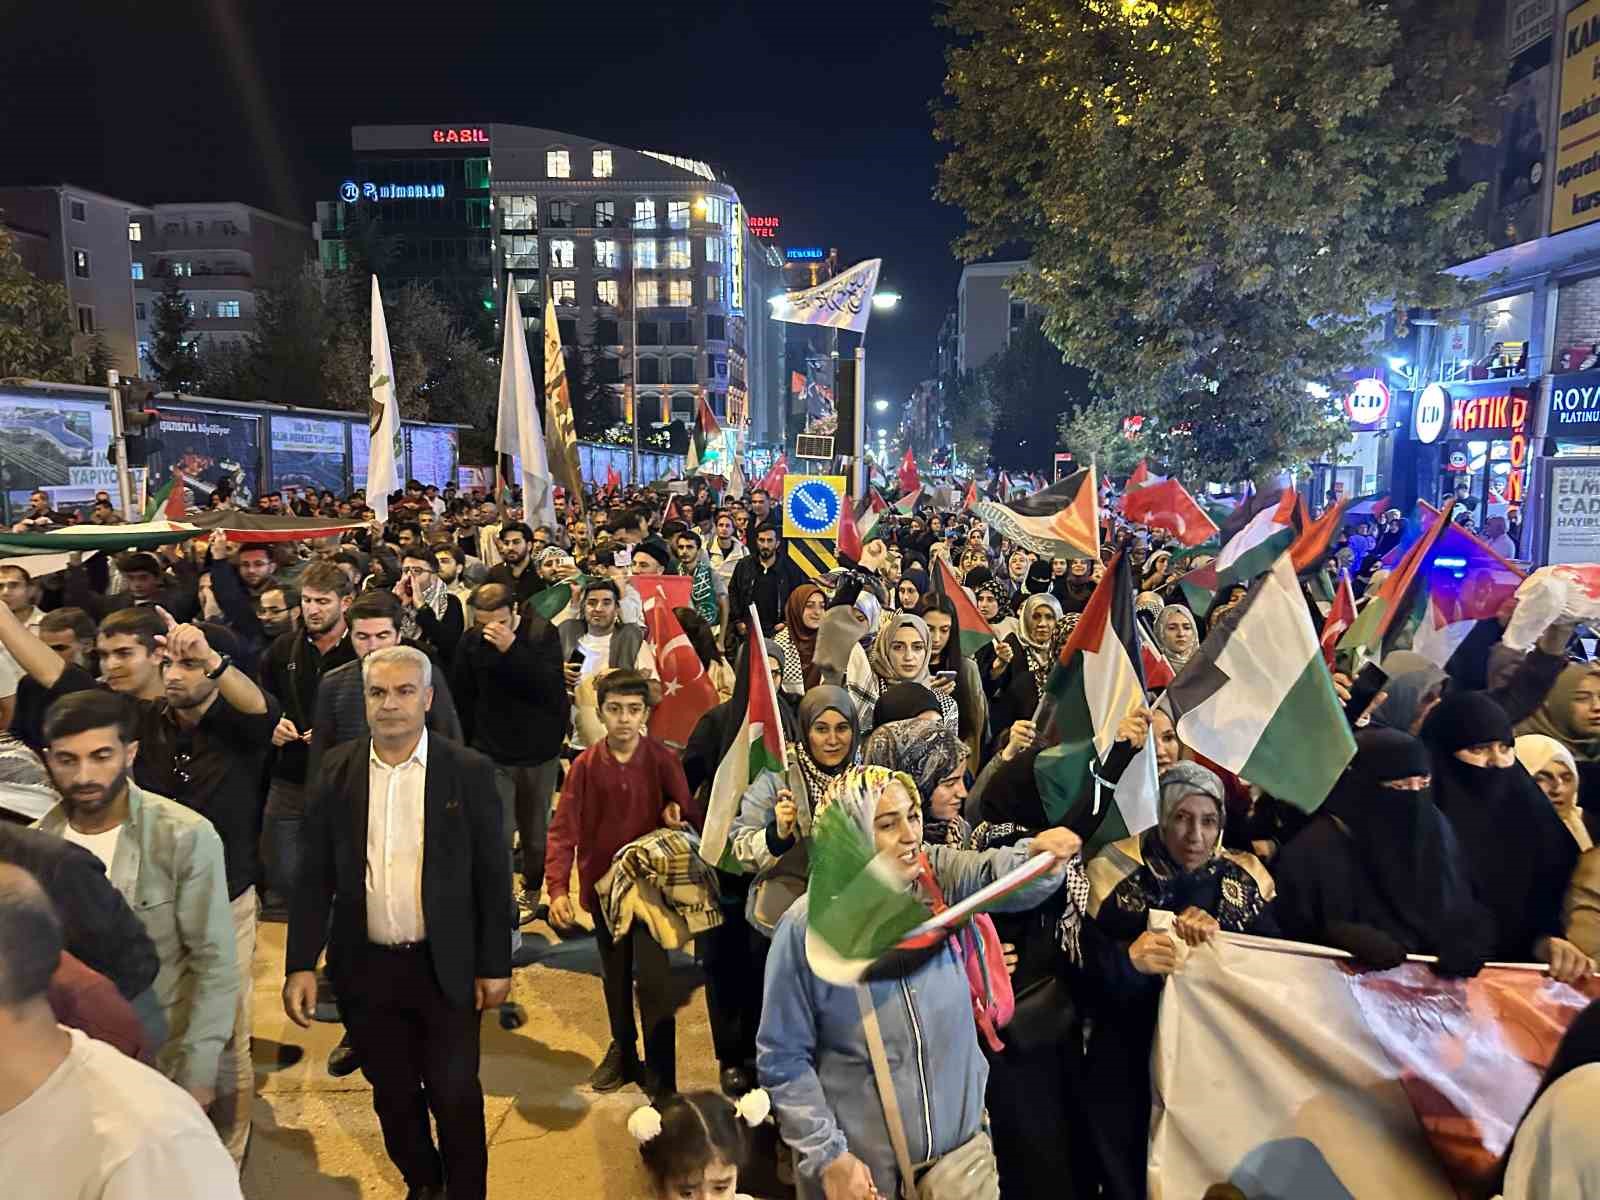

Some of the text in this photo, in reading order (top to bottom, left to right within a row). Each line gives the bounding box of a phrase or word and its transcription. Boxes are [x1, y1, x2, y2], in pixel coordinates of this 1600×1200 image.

[747, 216, 780, 227] RDUR
[1453, 396, 1508, 432] KATIK
[1560, 410, 1600, 423] PLATINU
